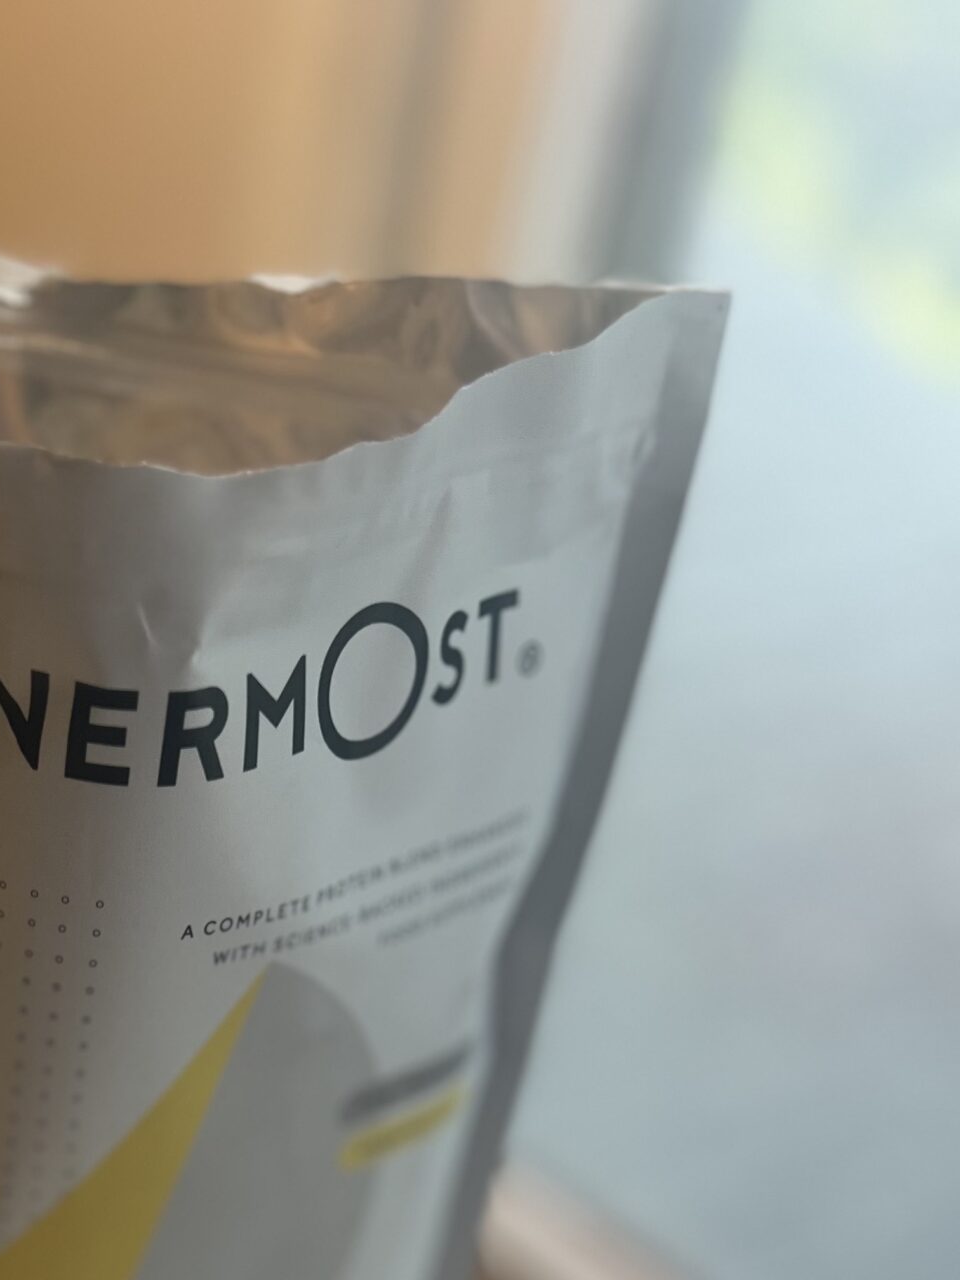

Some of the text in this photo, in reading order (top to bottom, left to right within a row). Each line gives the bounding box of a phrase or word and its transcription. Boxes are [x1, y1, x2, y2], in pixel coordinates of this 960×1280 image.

[180, 924, 195, 941] A
[203, 895, 312, 937] COMPLETE
[212, 940, 267, 966] WITH
